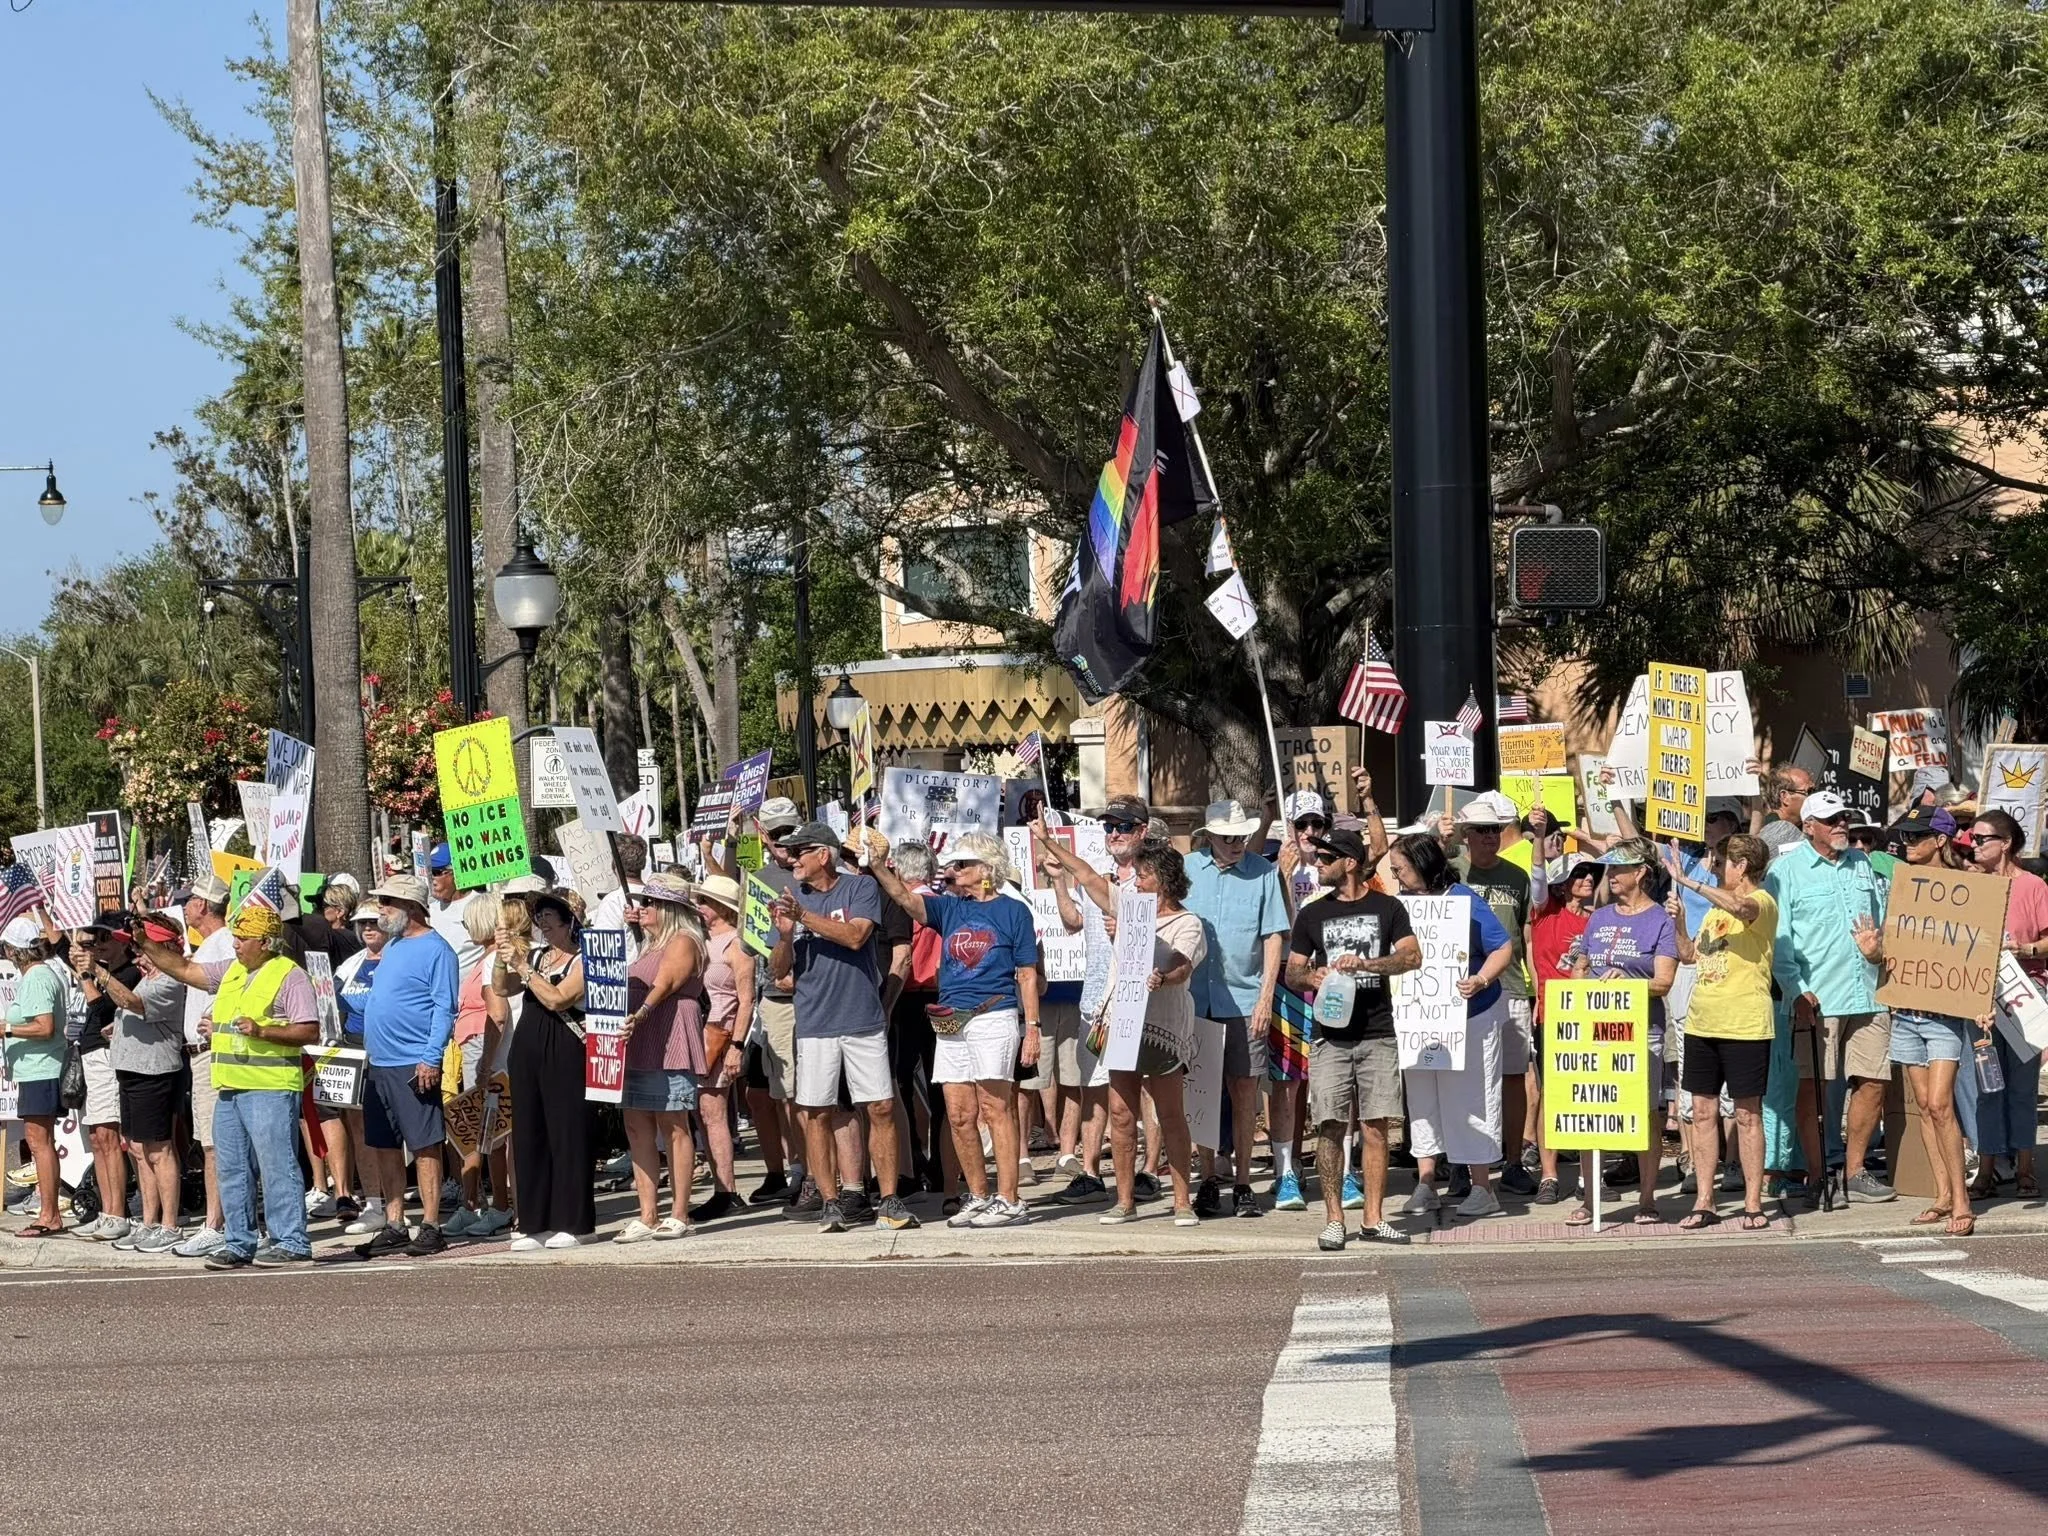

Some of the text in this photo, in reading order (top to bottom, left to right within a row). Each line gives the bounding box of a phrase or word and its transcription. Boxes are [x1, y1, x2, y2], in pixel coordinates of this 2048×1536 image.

[1654, 669, 1699, 696] IF THERE'S
[1652, 697, 1701, 724] MONEY FOR A
[1876, 712, 1926, 734] TRUMP
[1278, 738, 1332, 756] TACO
[1500, 740, 1535, 751] FIGHTING
[1665, 725, 1688, 750] WAR
[272, 732, 289, 764] WE
[1428, 744, 1471, 757] YOUR VOTE
[1853, 737, 1884, 761] EPSTEIN
[1282, 760, 1342, 776] S NOT A
[1436, 757, 1470, 768] IS YOUR
[1502, 754, 1536, 764] TOGETHER
[1661, 752, 1690, 777] THERE'S
[1914, 751, 1948, 767] FELO
[738, 762, 766, 784] KINGS
[1436, 768, 1467, 780] POWER
[1706, 761, 1746, 780] ELON
[905, 774, 990, 789] DICTATOR?
[733, 783, 761, 803] ERICA
[1652, 779, 1698, 805] MONEY FOR
[1858, 784, 1880, 808] into
[274, 809, 302, 829] DUMP
[452, 803, 506, 829] NO ICE
[902, 804, 916, 820] OR
[966, 808, 981, 823] OR
[1658, 808, 1691, 832] MEDICAID
[270, 829, 300, 860] TRUMP
[456, 826, 512, 852] NO WAR
[460, 844, 524, 873] NO KINGS
[96, 878, 121, 896] CRUELTY
[1911, 877, 1970, 906] TOO
[753, 905, 770, 926] the
[584, 932, 622, 958] TRUMP
[1127, 924, 1149, 947] BOMB
[1896, 914, 1981, 962] MANY
[1442, 943, 1458, 960] OF
[588, 960, 595, 976] is
[596, 960, 606, 978] the
[1885, 956, 1991, 996] REASONS
[1356, 977, 1381, 989] NIE
[588, 980, 627, 1012] PRESIDENT
[1561, 991, 1630, 1010] IF YOU'RE
[1420, 1004, 1451, 1020] NOT
[1400, 1031, 1466, 1052] TORSHIP
[1557, 1022, 1634, 1042] NOT ANGRY
[596, 1035, 618, 1056] SINCE
[318, 1066, 352, 1077] TRUMP-
[590, 1056, 622, 1085] TRUMP
[1555, 1052, 1636, 1072] YOU'RE NOT
[315, 1078, 352, 1090] EPSTEIN
[1572, 1084, 1618, 1103] PAYING
[320, 1090, 344, 1102] FILES
[1555, 1114, 1624, 1133] ATTENTION
